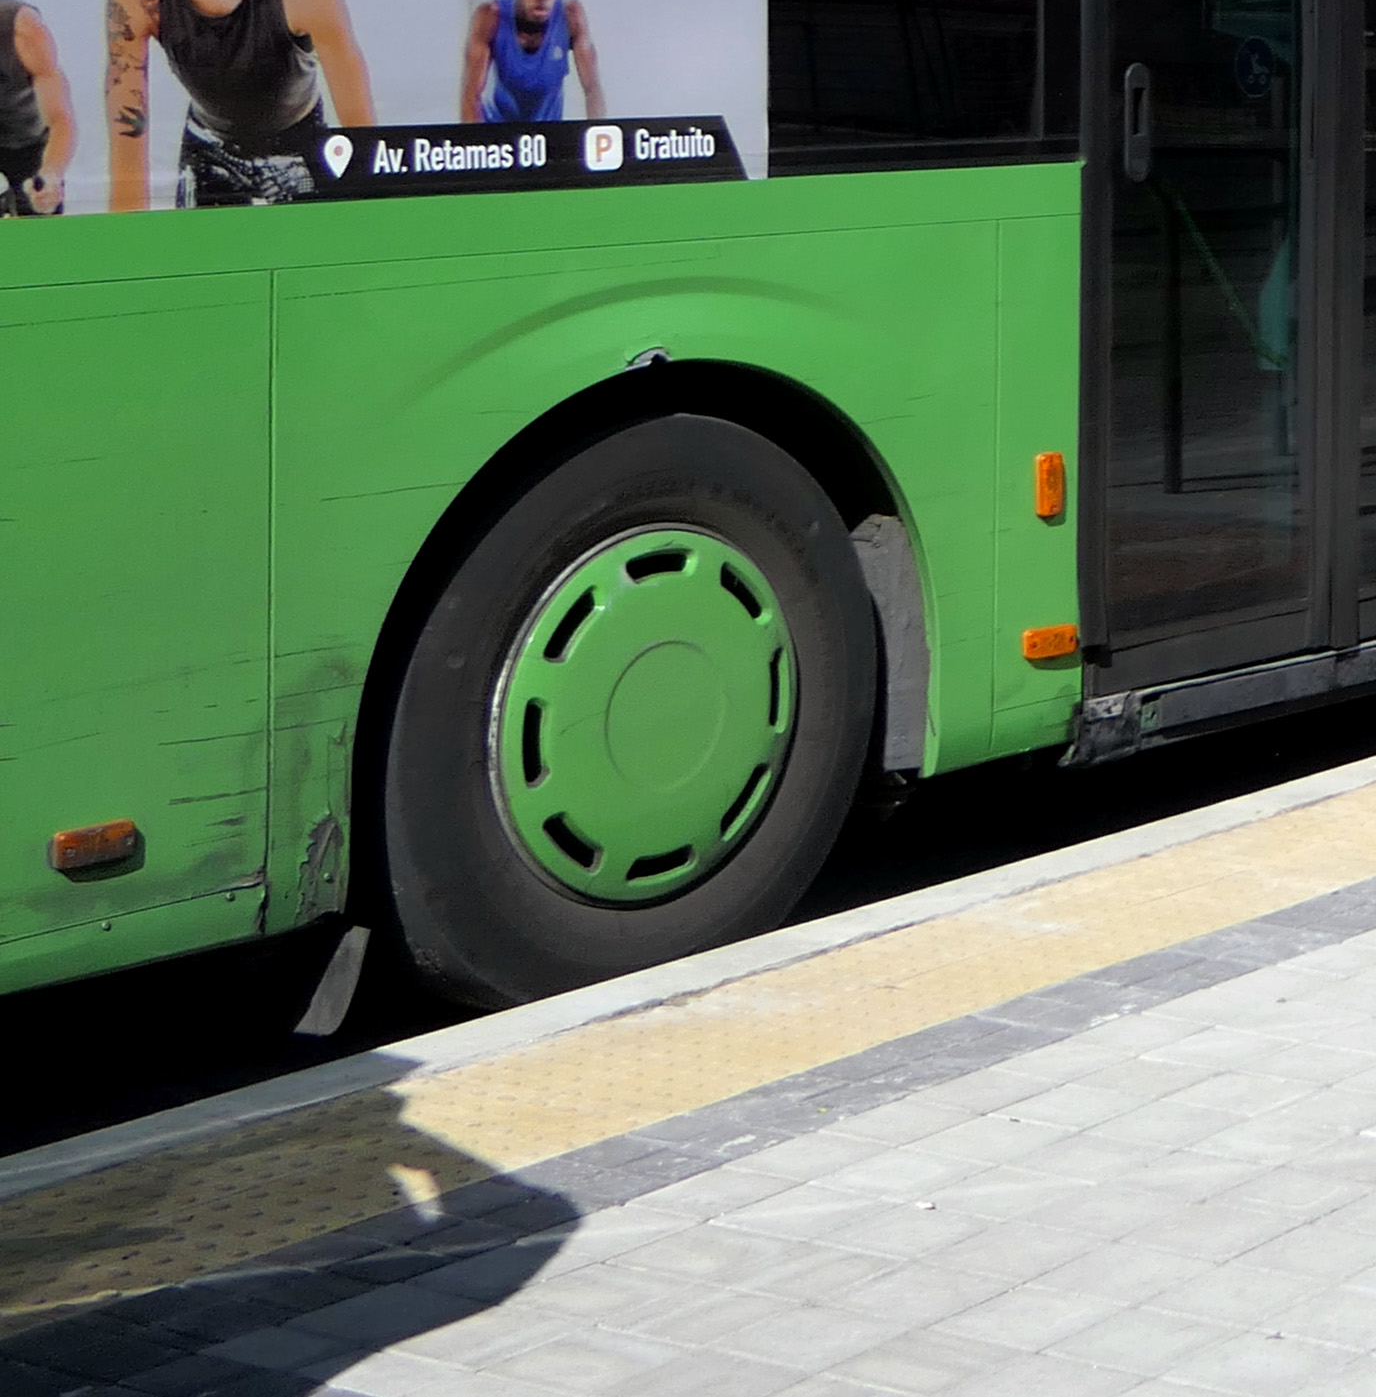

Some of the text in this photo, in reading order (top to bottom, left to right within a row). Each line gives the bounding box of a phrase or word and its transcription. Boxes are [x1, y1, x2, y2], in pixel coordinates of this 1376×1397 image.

[373, 139, 409, 174] Av.
[413, 138, 514, 174] Retamas
[517, 134, 547, 168] 80
[634, 126, 716, 161] Gratuito
